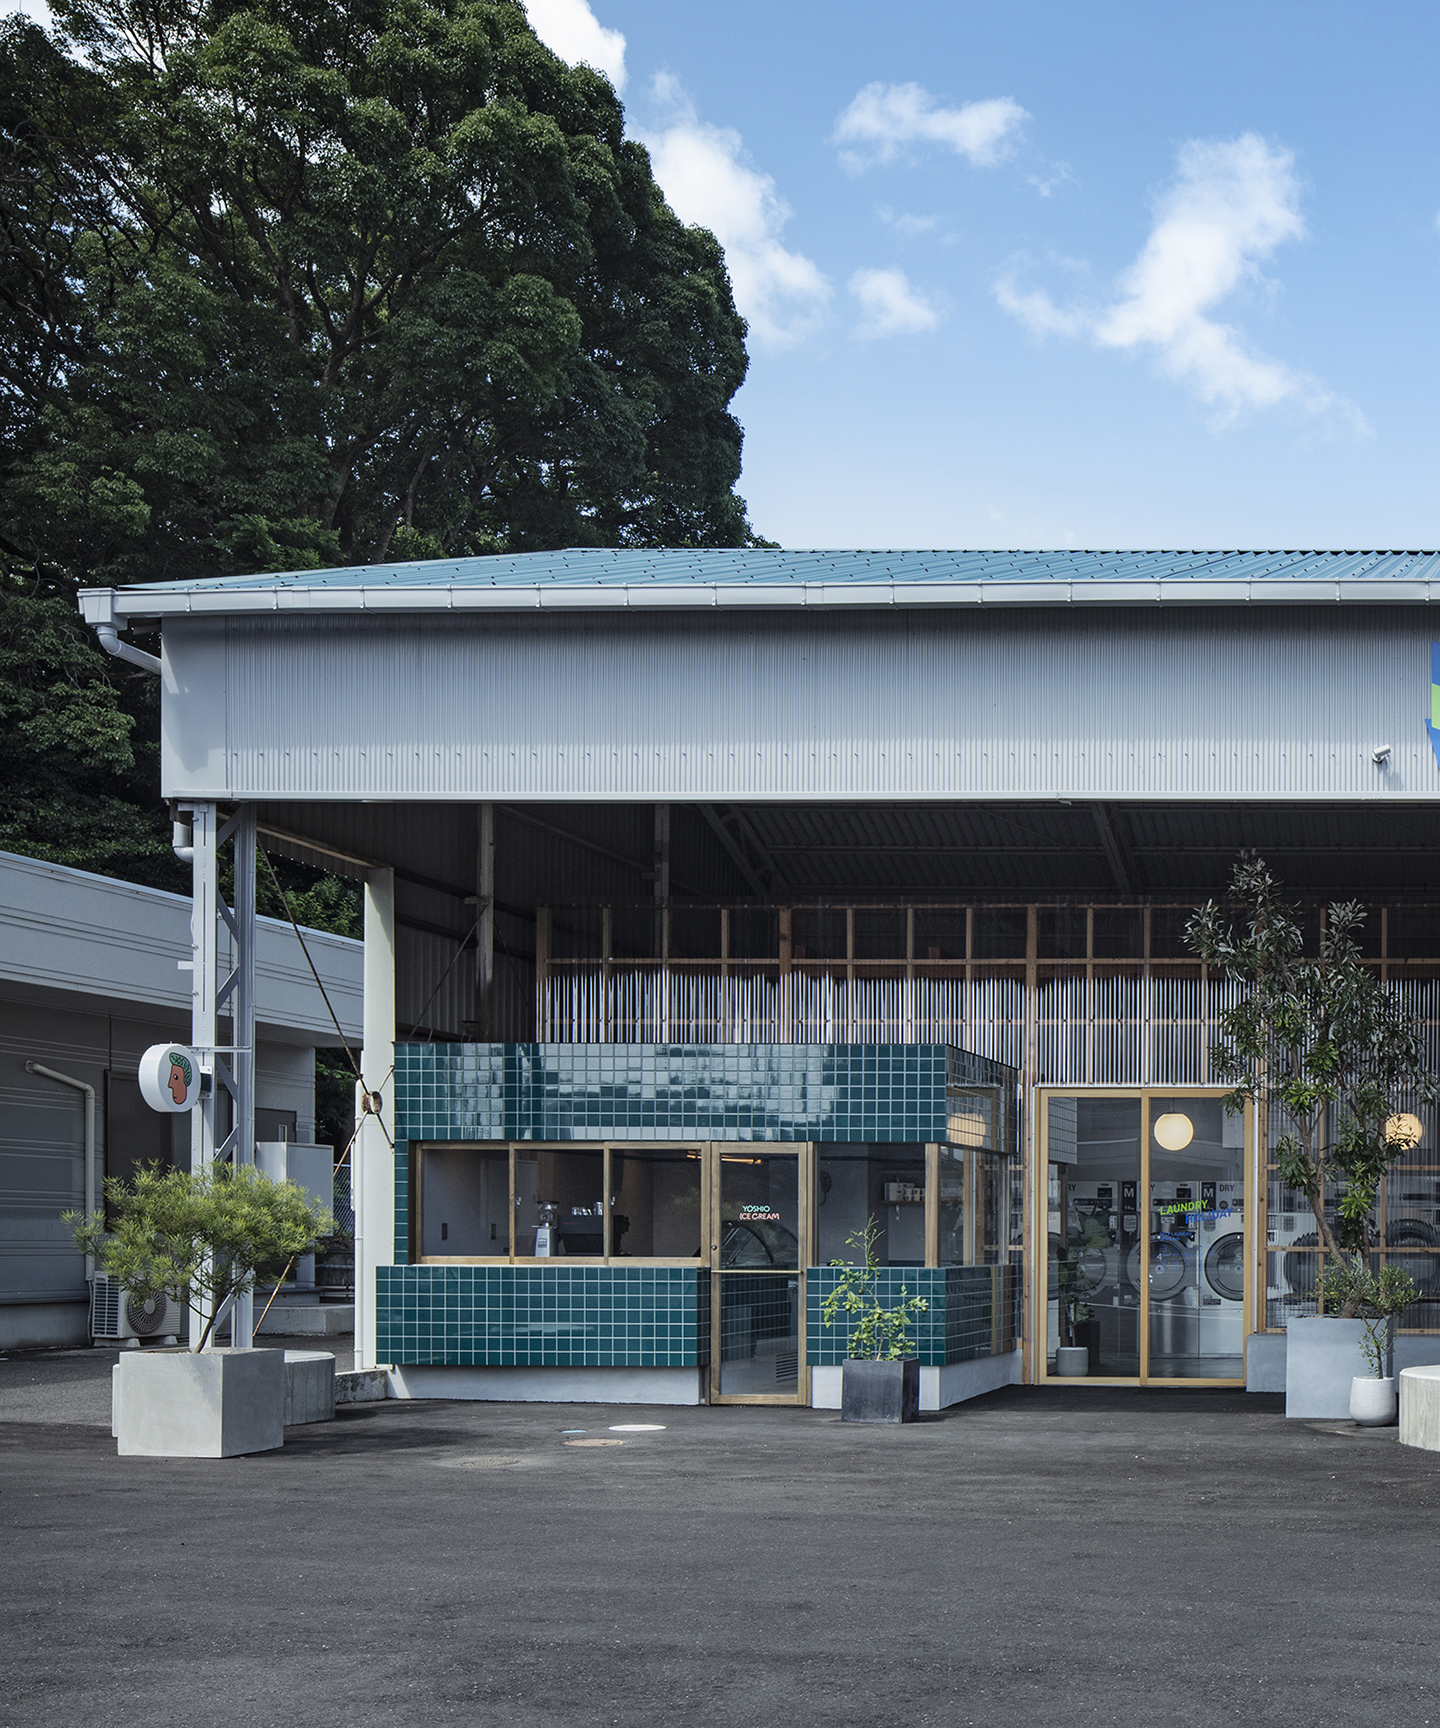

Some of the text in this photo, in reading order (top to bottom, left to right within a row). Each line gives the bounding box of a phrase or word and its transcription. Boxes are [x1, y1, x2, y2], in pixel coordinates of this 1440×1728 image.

[1124, 1187, 1135, 1198] M
[1203, 1188, 1214, 1198] M
[1219, 1184, 1235, 1192] DRY
[1160, 1199, 1208, 1215] LAUNDRY
[1185, 1207, 1233, 1224] HOLIDAY
